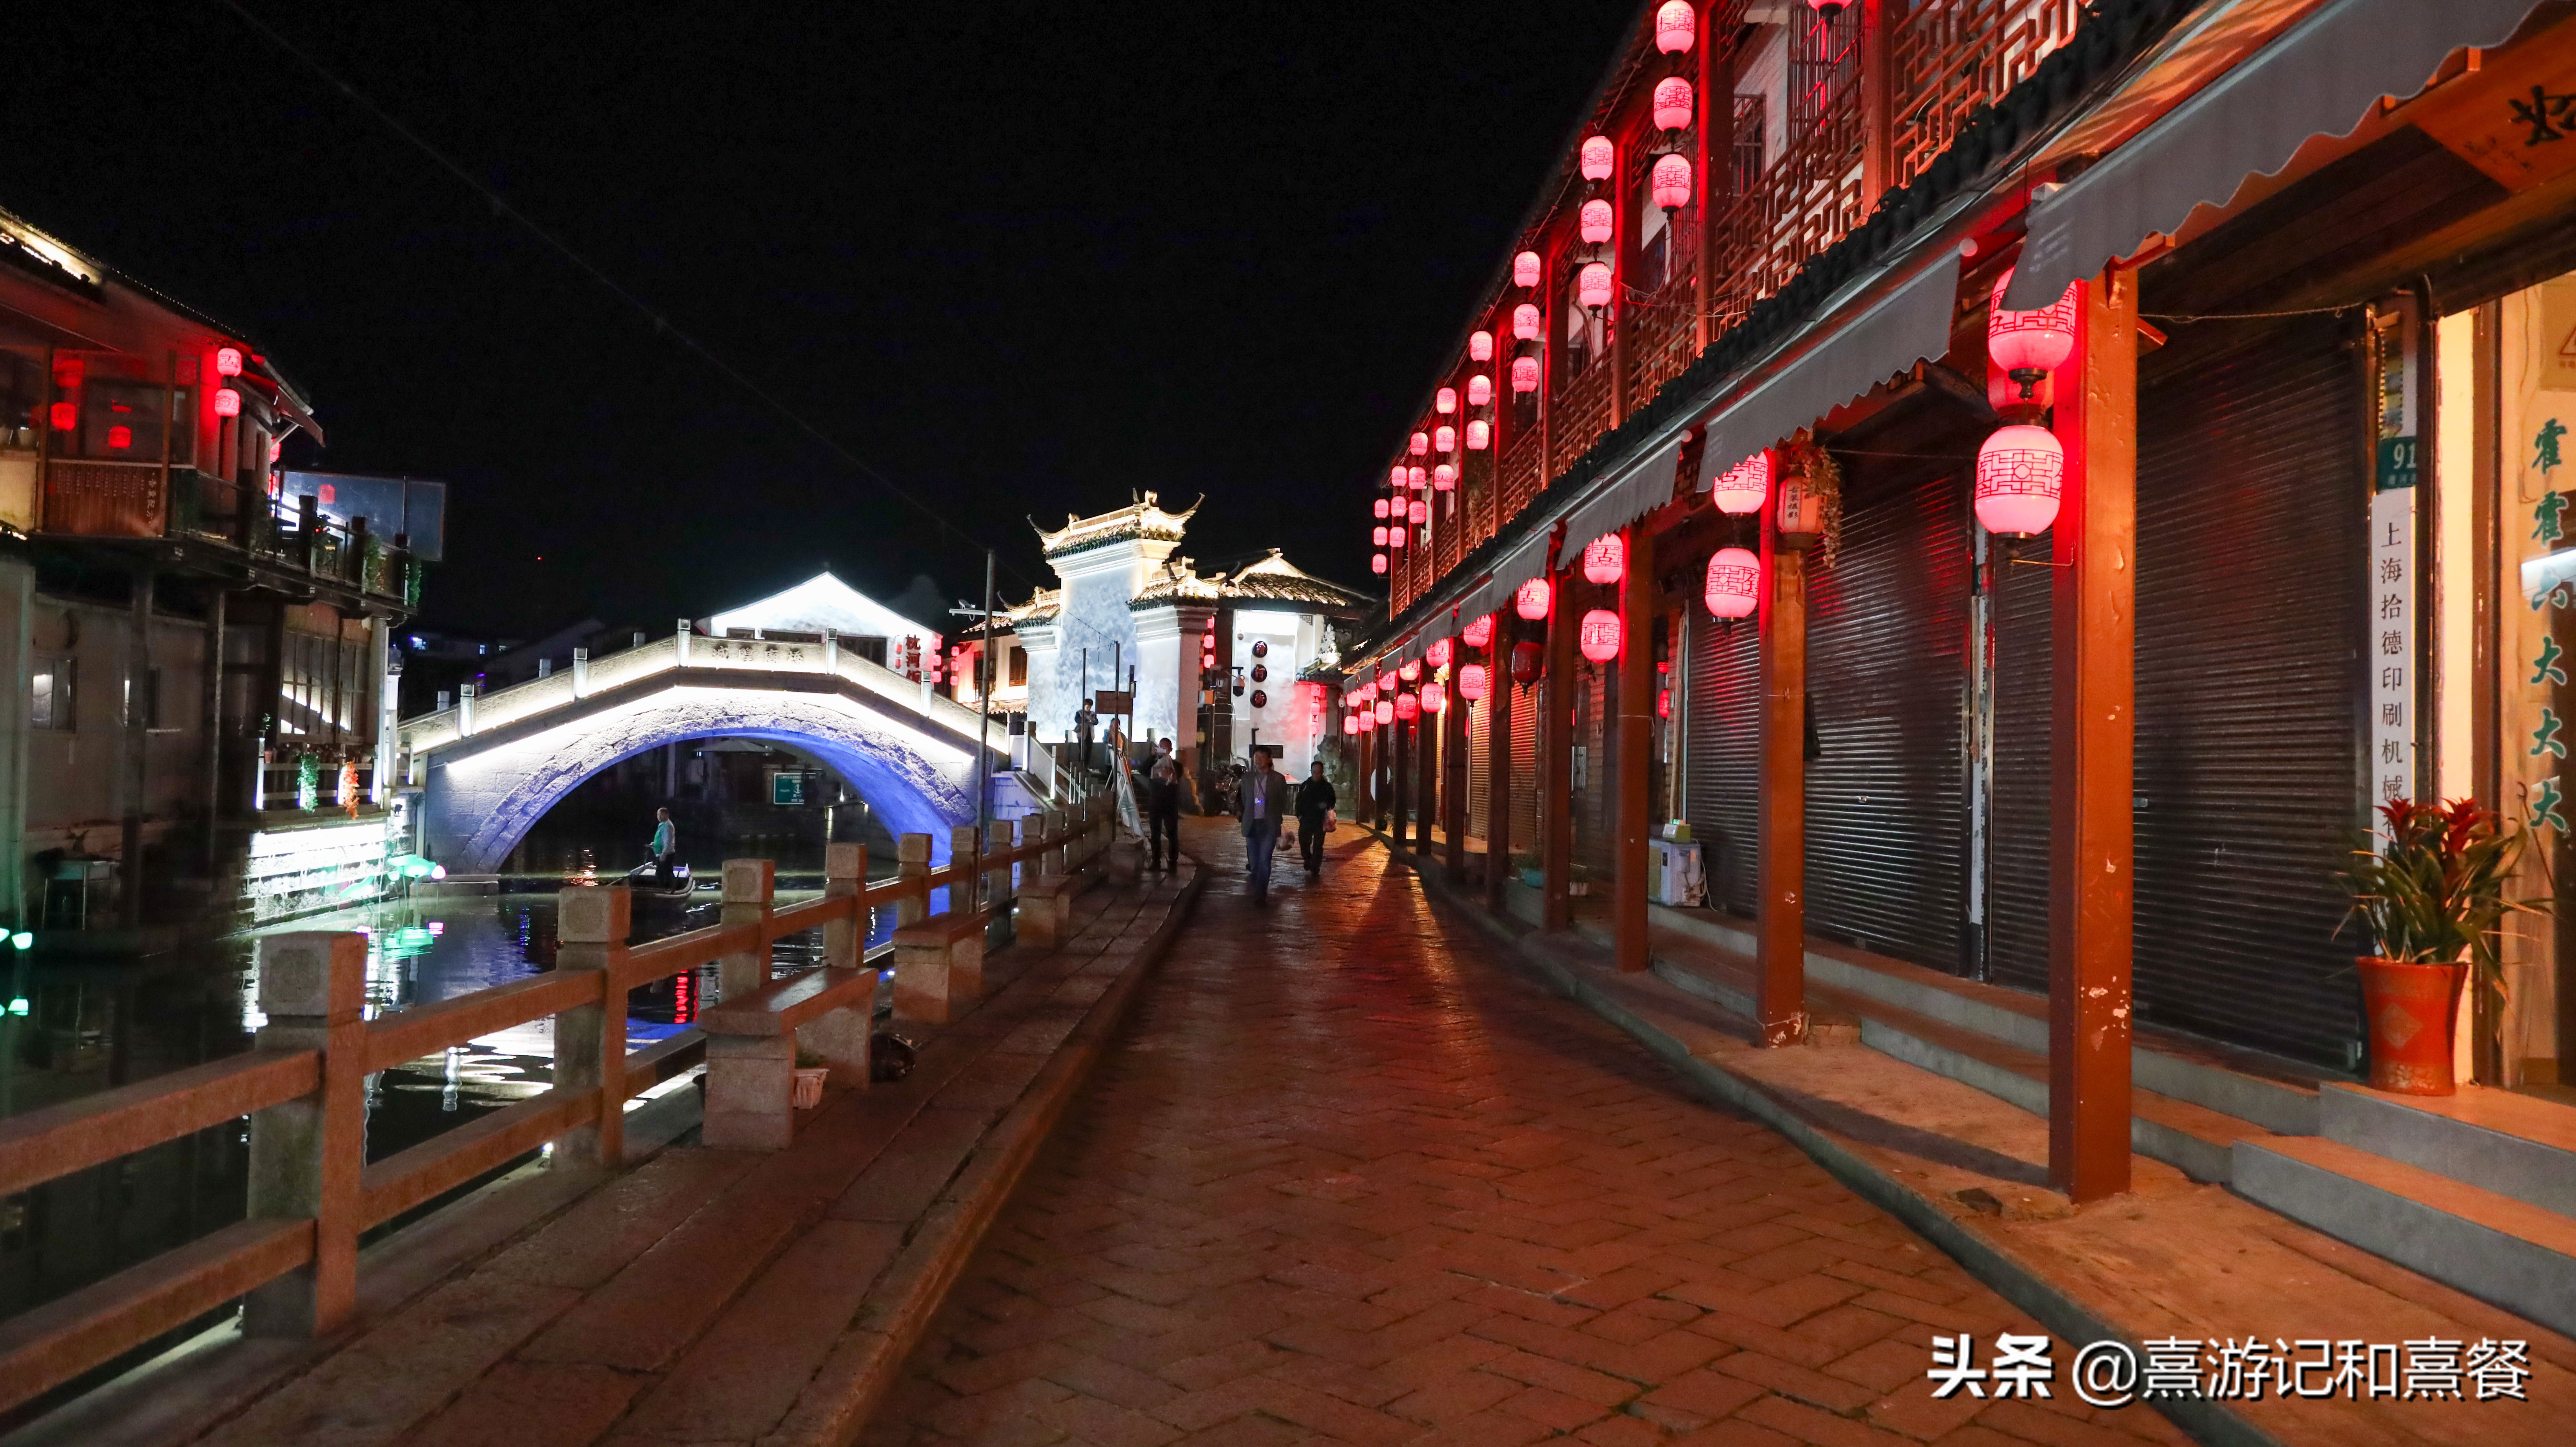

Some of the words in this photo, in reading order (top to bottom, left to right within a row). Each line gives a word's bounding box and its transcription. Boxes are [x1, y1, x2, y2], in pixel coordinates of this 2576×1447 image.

[2394, 443, 2416, 469] 91
[2380, 522, 2402, 858] 上海拾德印刷机械
